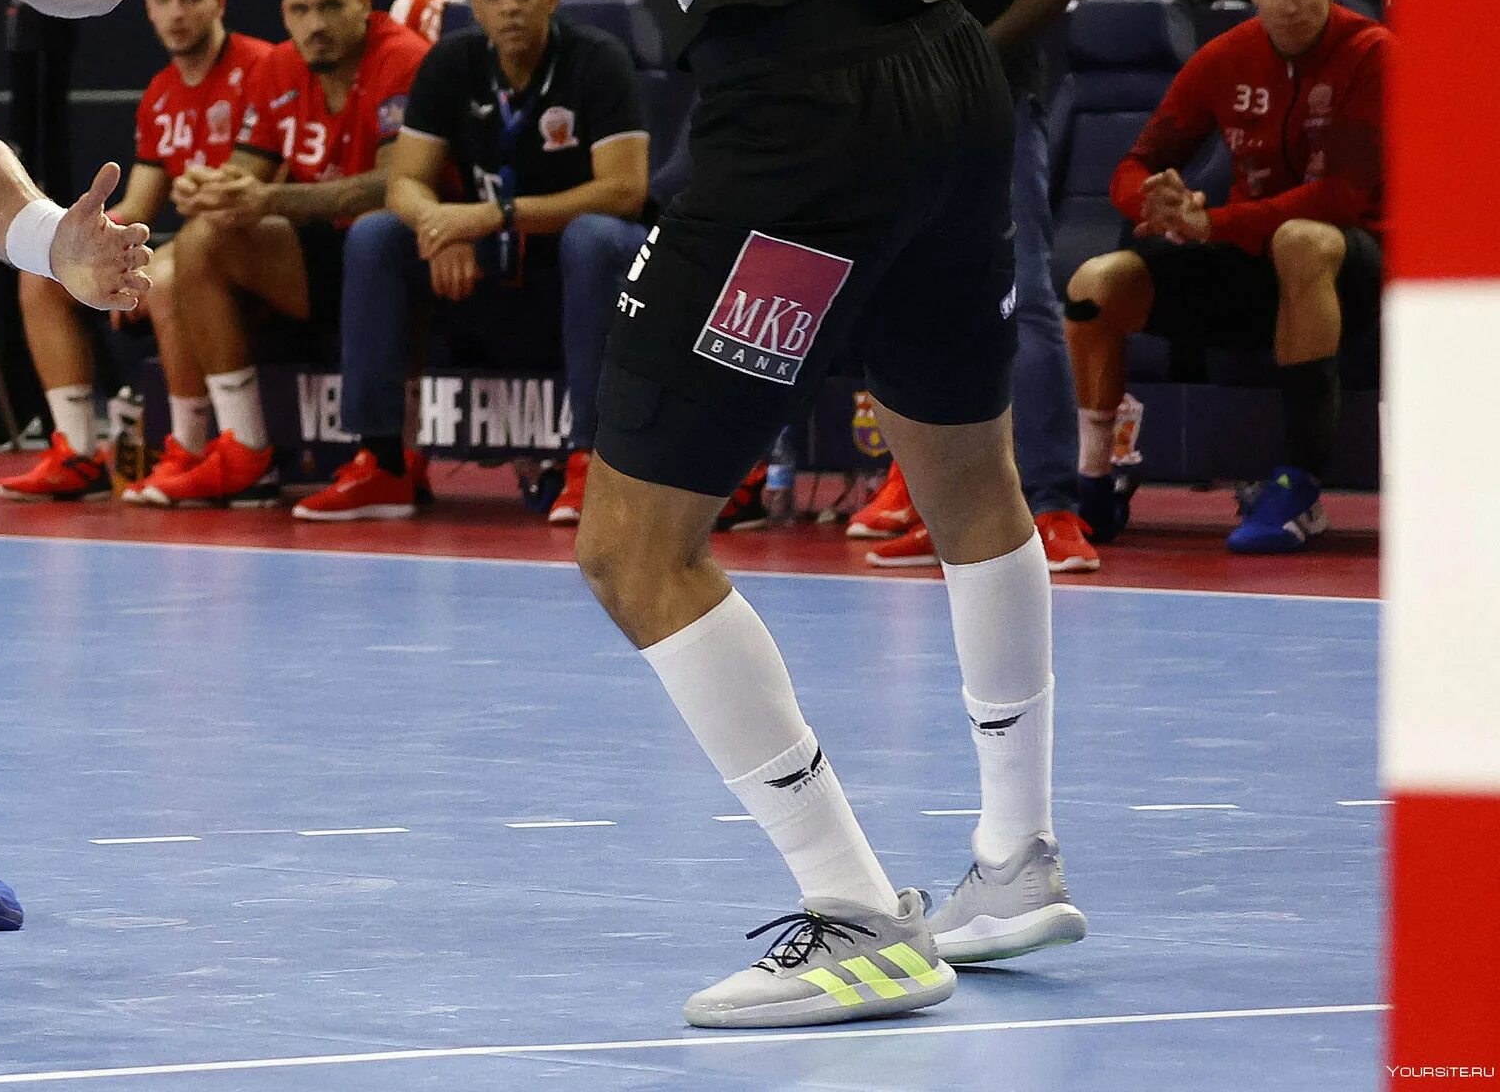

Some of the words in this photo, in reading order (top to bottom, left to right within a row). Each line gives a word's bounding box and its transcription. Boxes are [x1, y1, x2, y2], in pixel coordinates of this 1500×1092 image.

[1232, 83, 1270, 115] 33
[154, 111, 194, 158] 24
[278, 116, 327, 166] 13
[719, 289, 813, 354] MKB
[709, 338, 791, 376] BANK
